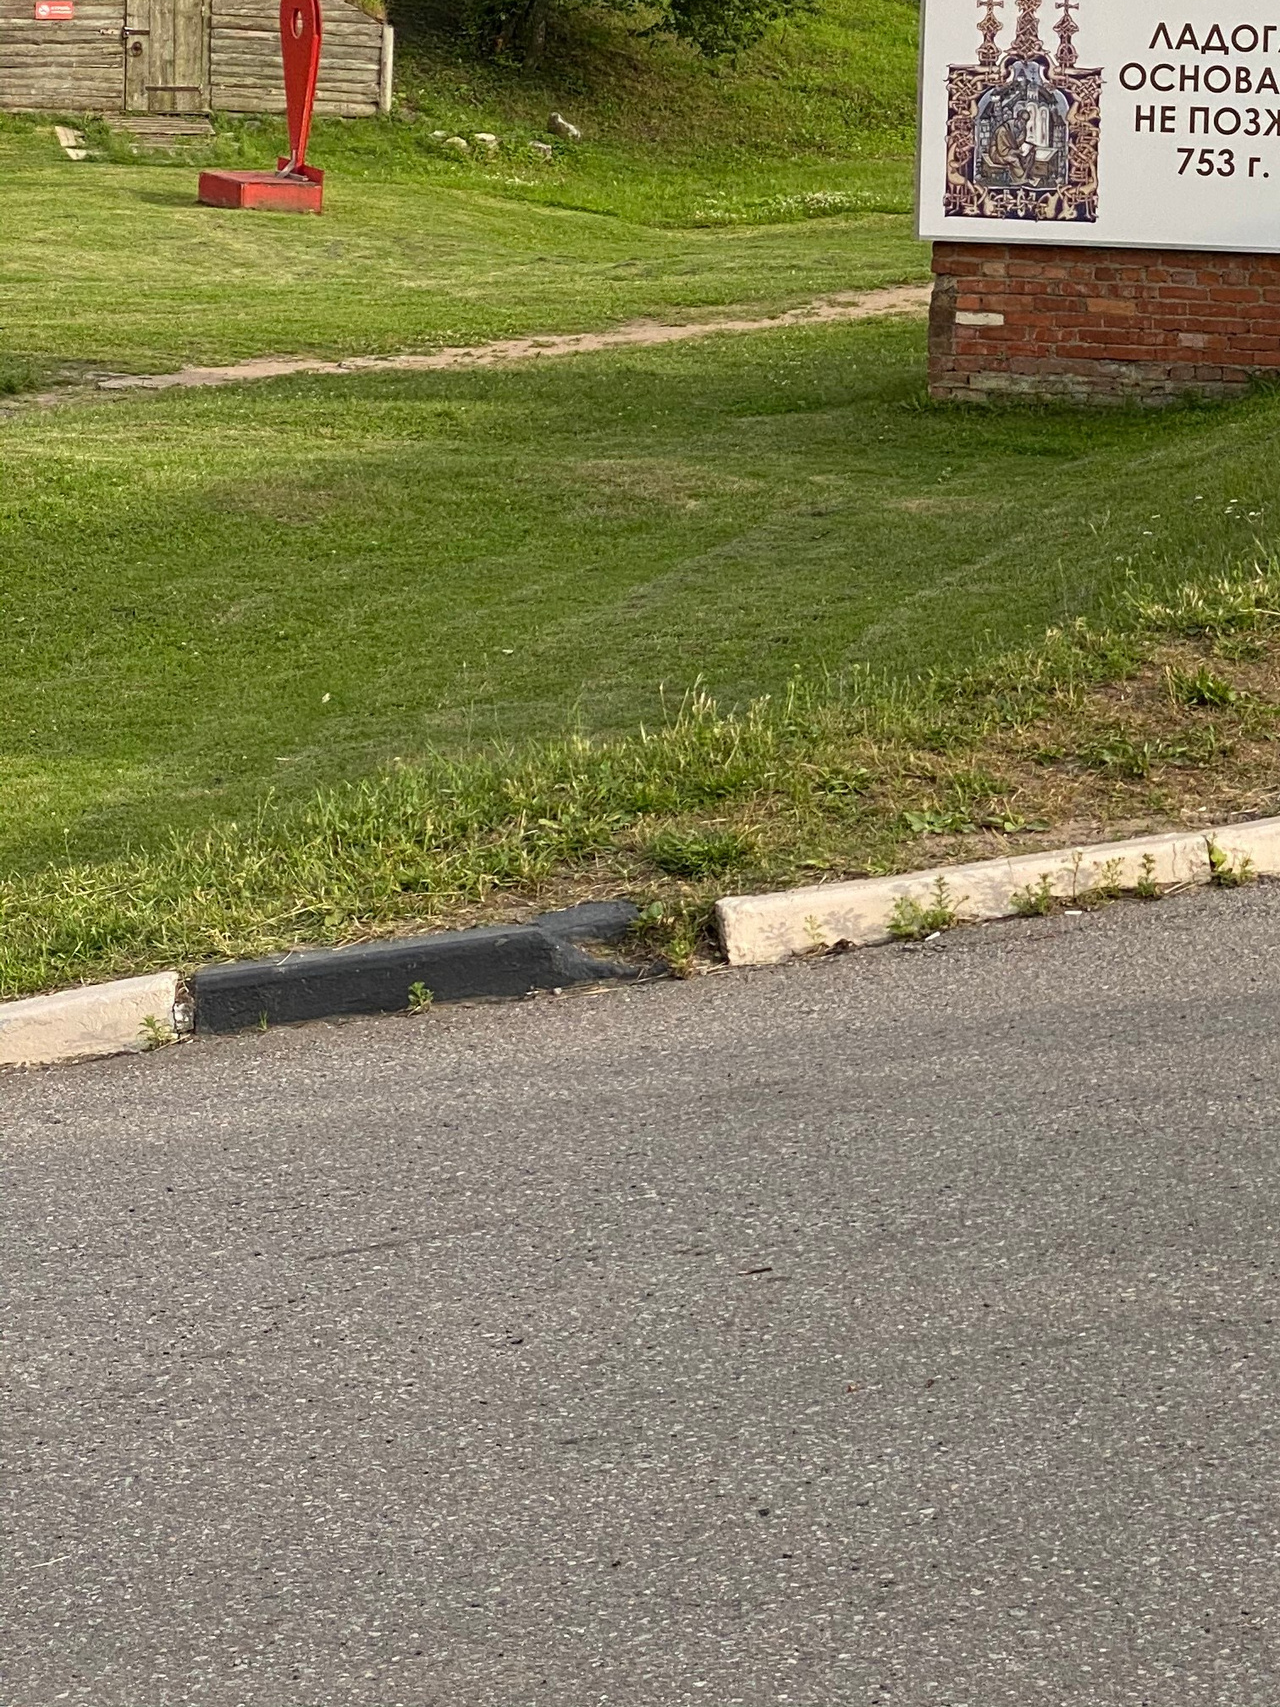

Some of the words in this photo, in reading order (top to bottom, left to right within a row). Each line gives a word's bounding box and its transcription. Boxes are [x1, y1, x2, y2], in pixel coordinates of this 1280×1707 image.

[1135, 104, 1176, 133] НЕ
[1176, 147, 1235, 177] 753
[1248, 157, 1269, 179] г.
